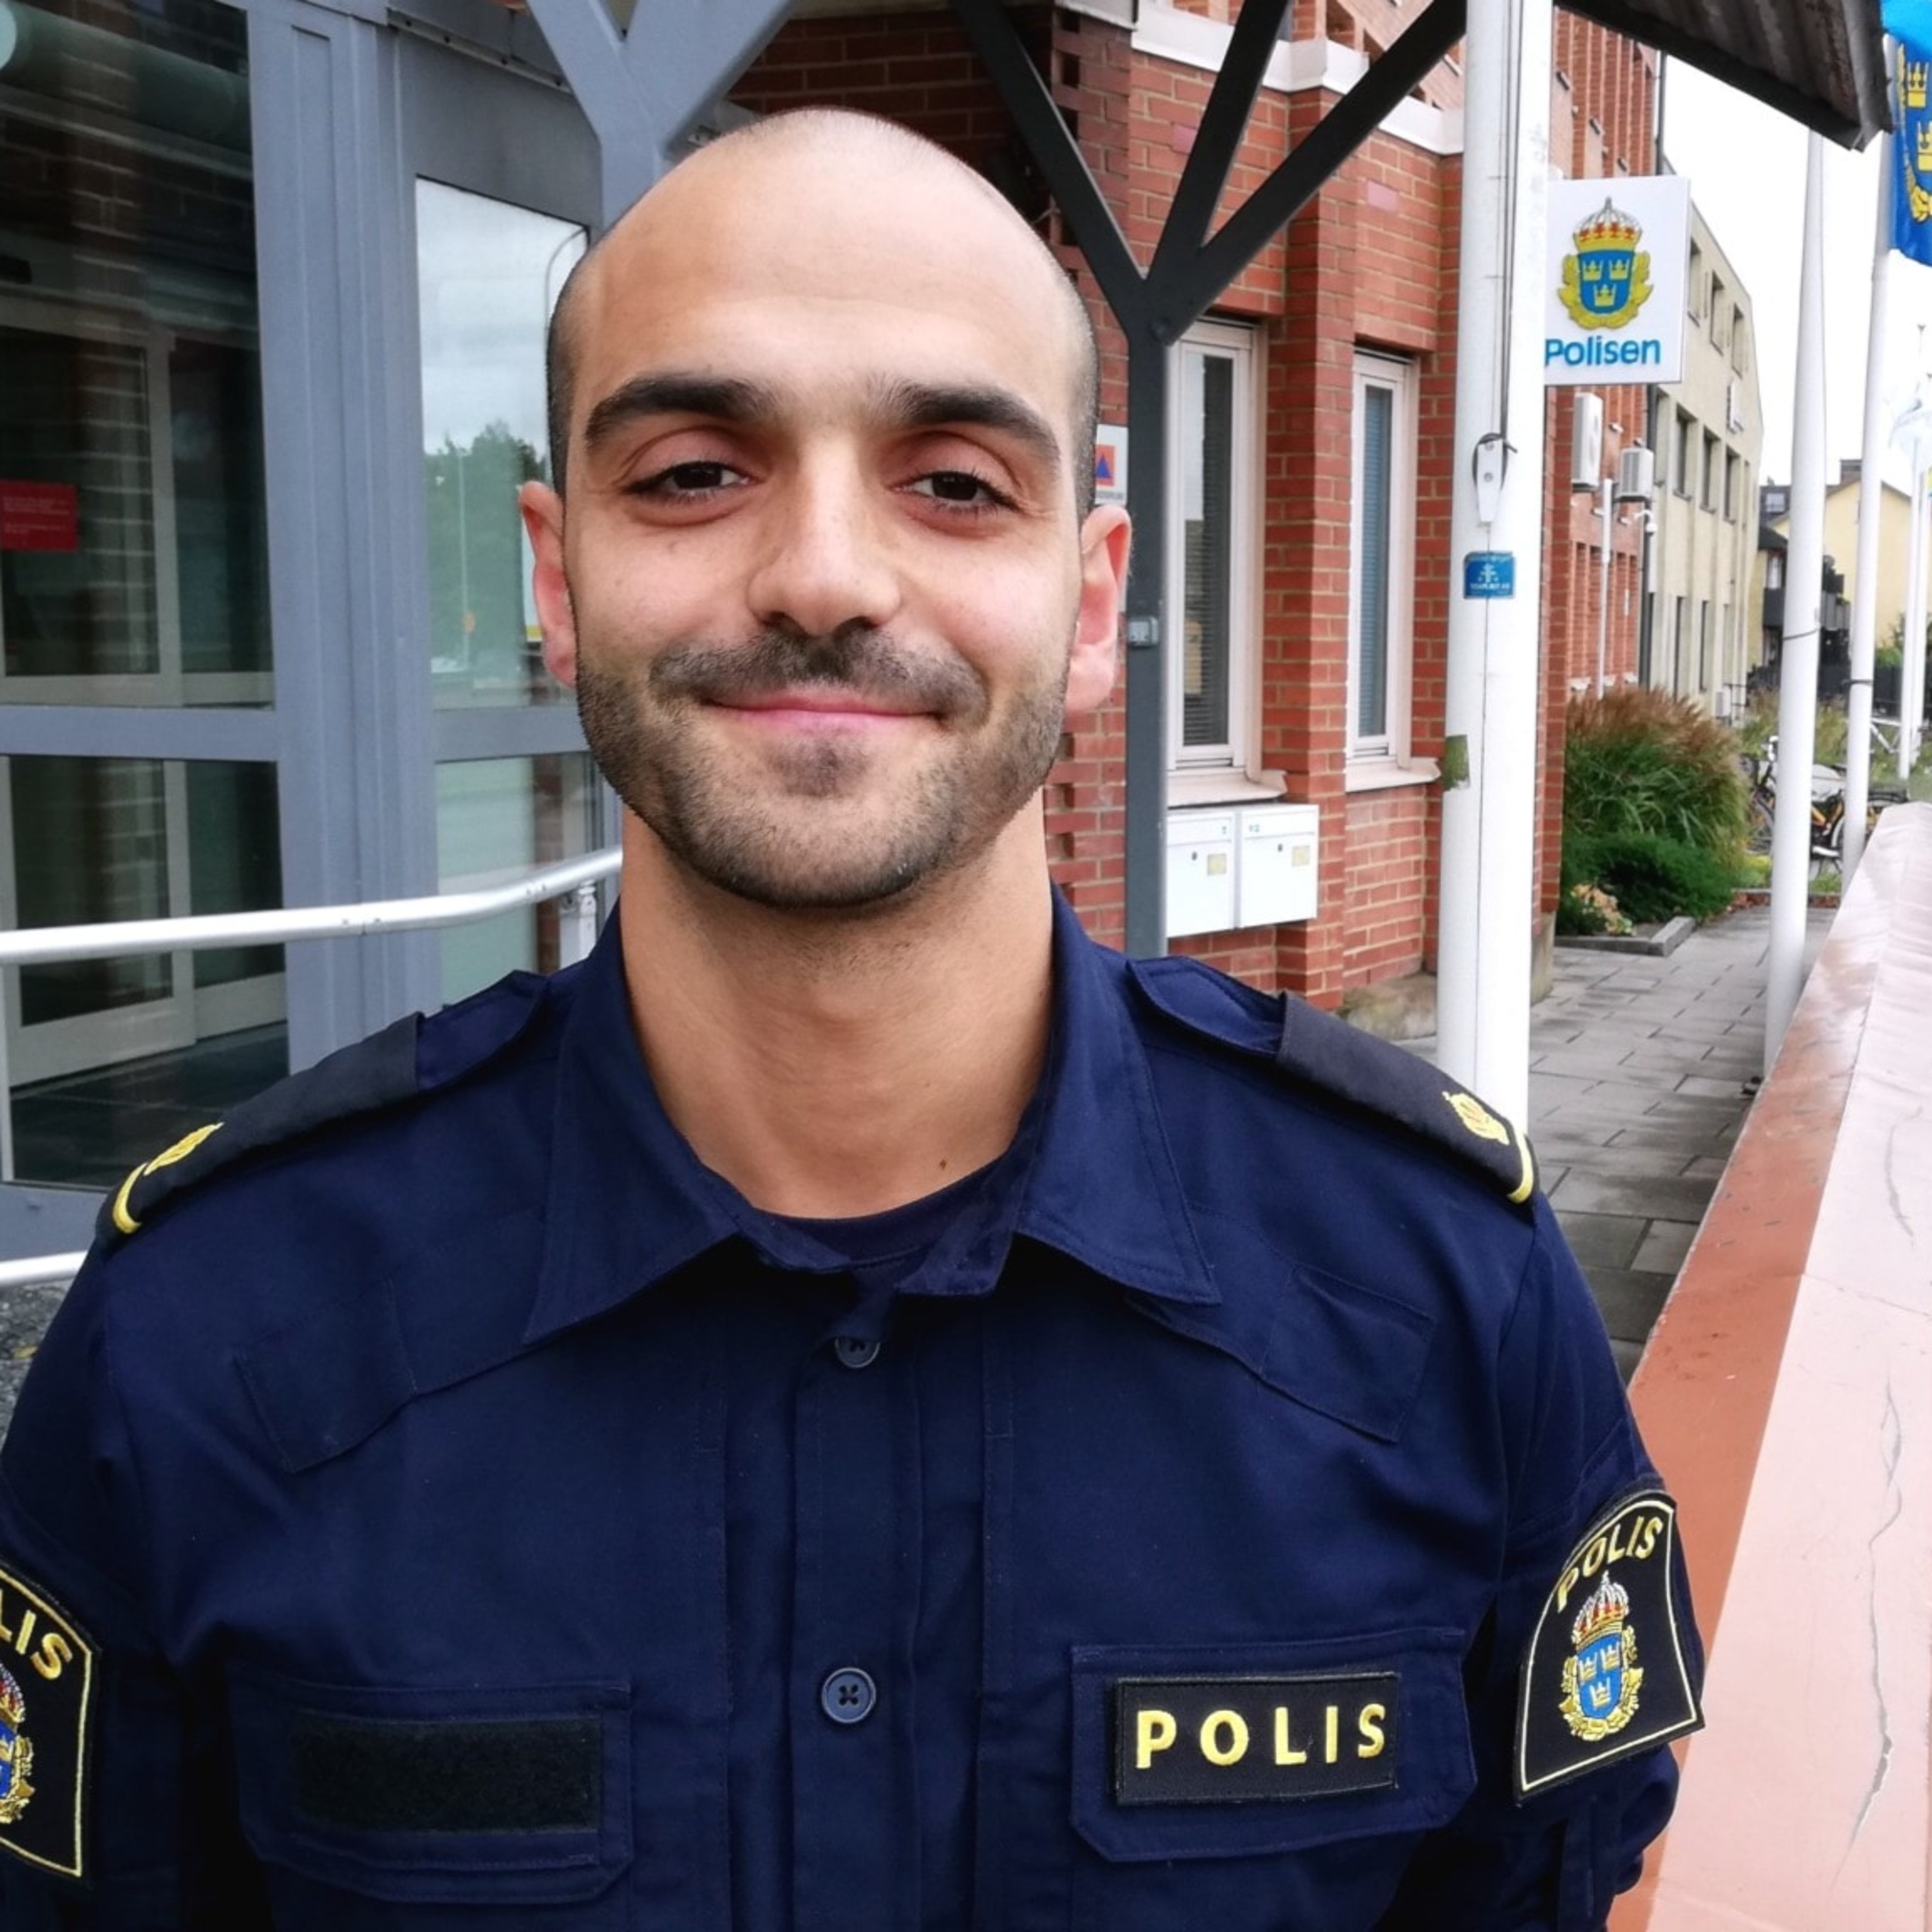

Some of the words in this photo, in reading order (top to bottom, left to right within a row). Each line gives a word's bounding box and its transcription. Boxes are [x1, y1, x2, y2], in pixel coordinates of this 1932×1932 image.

[1544, 336, 1661, 367] Polisen
[1557, 1515, 1663, 1613] POLIS
[1135, 1703, 1386, 1769] POLIS
